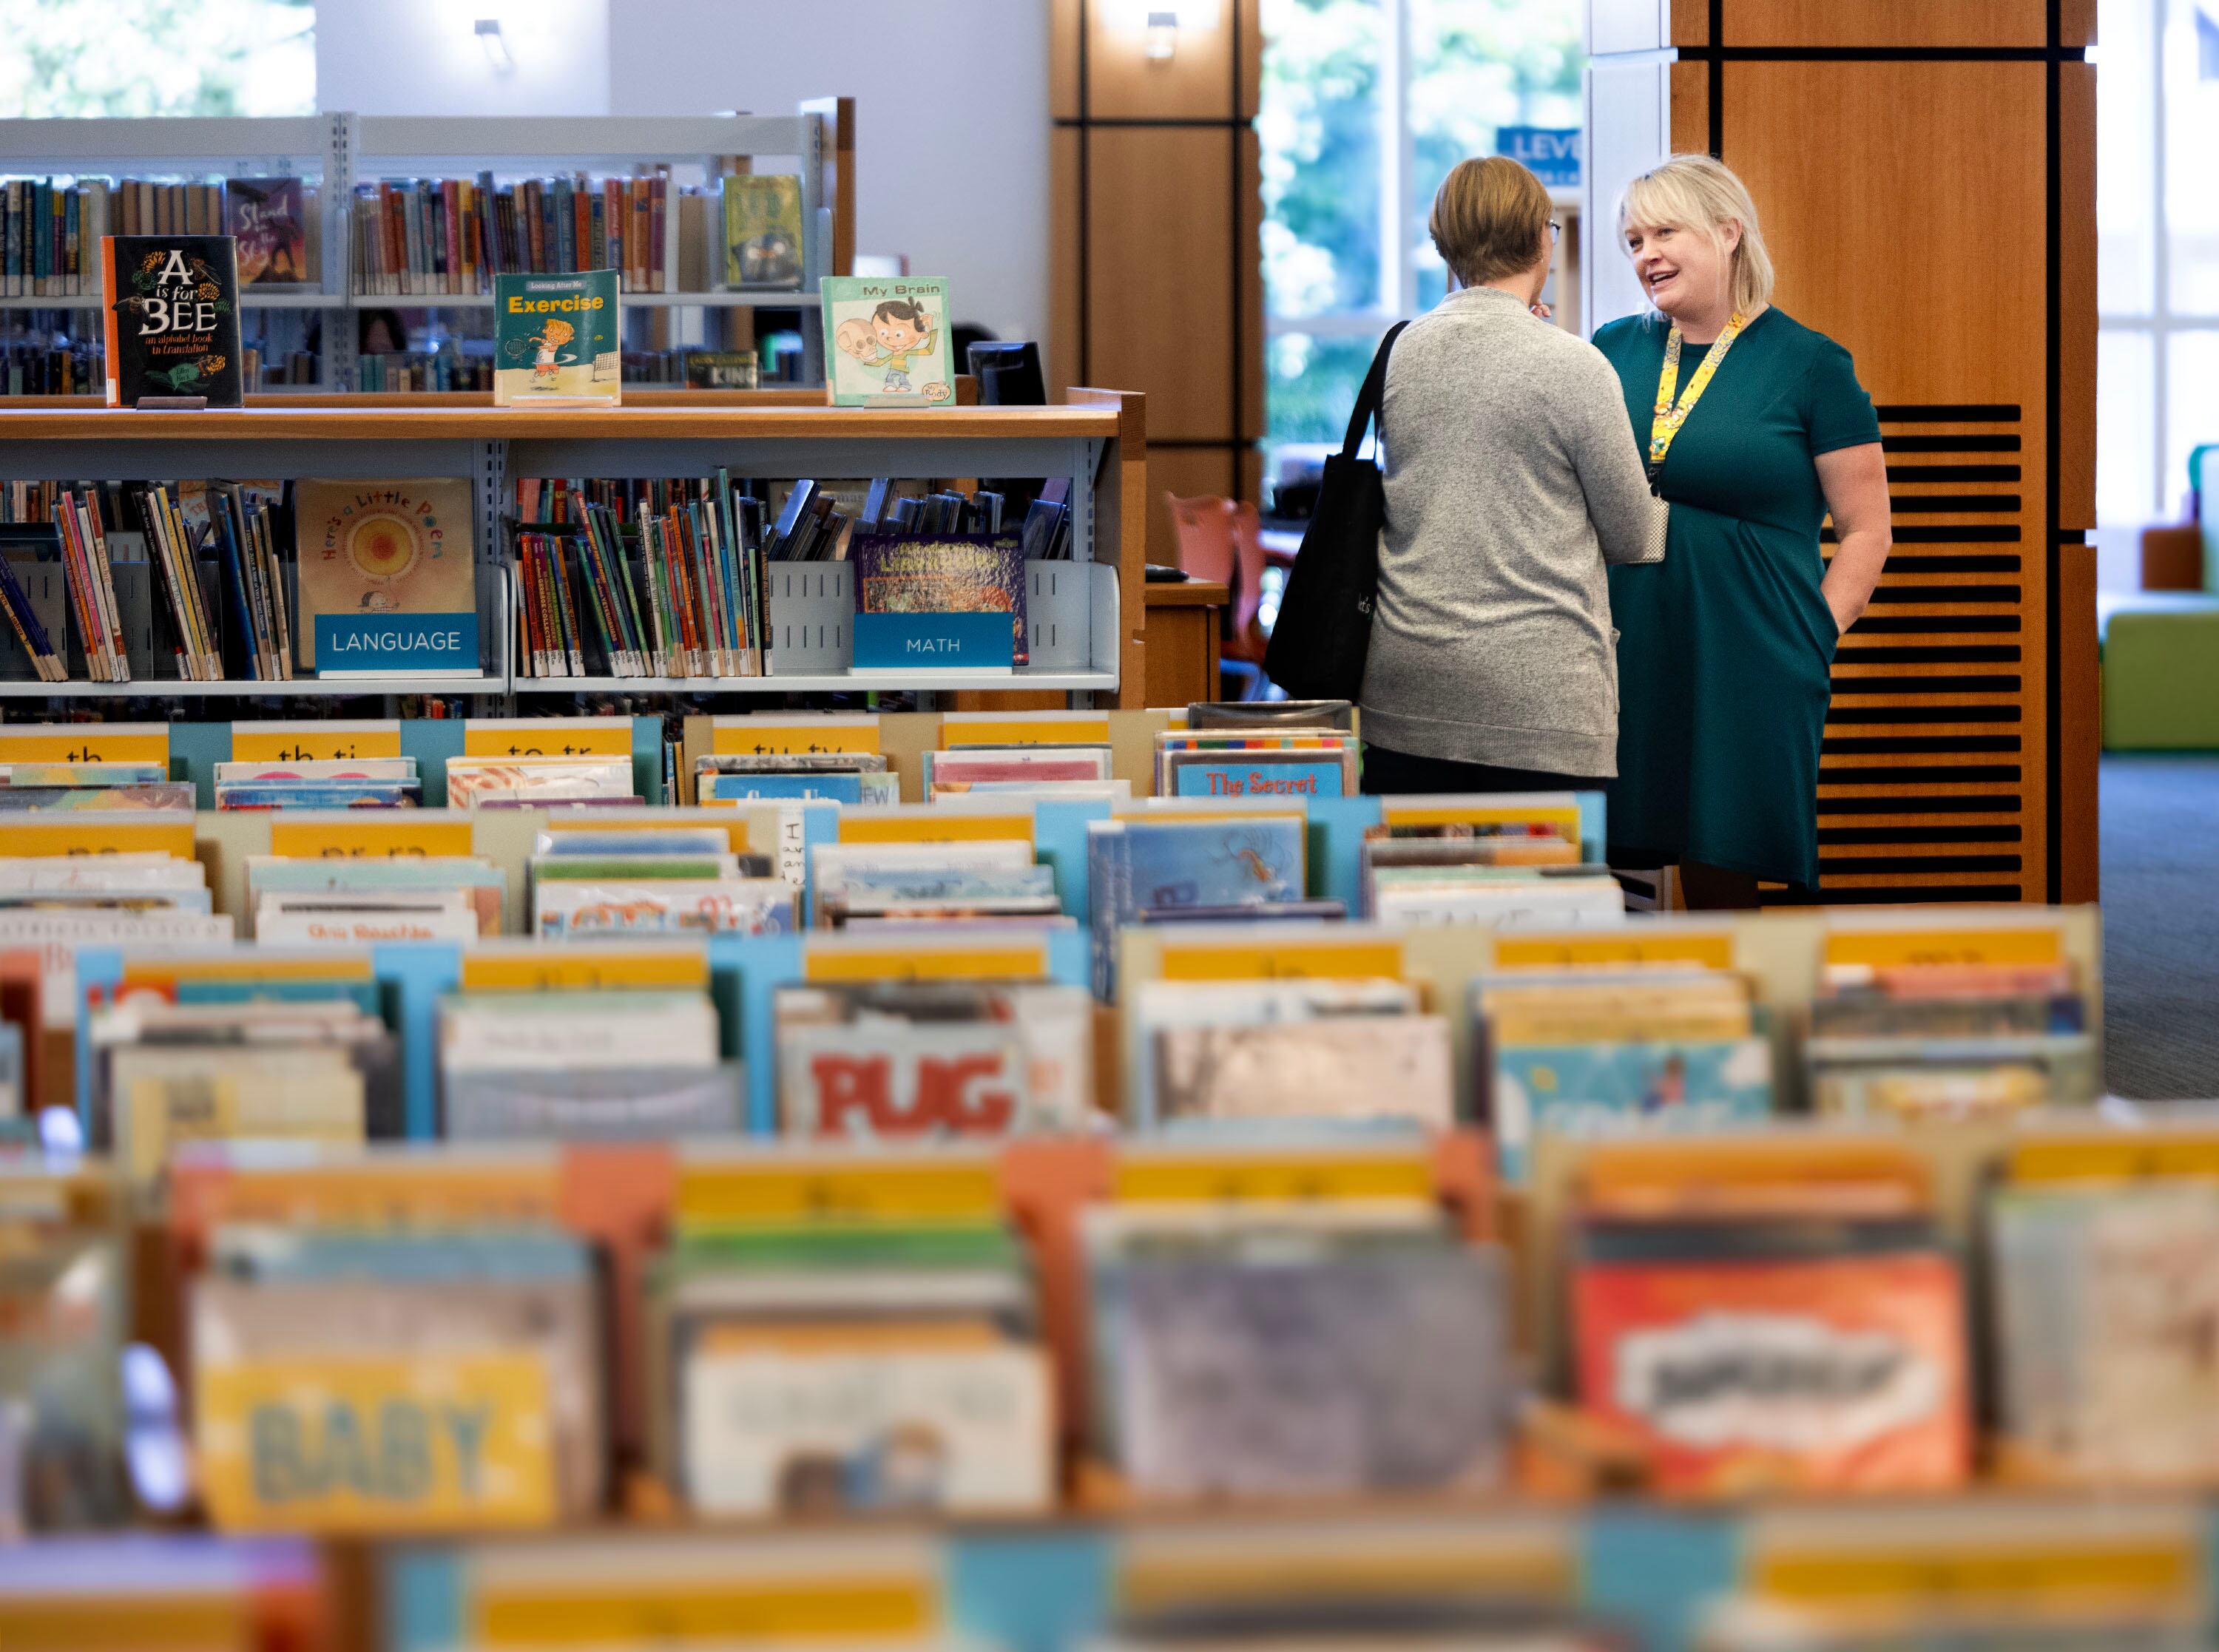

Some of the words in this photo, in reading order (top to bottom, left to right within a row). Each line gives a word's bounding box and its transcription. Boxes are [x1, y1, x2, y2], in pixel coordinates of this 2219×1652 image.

[158, 250, 194, 285] A
[156, 285, 169, 297] is
[172, 285, 198, 302] for
[863, 286, 888, 297] My
[895, 284, 940, 295] Brain
[508, 294, 604, 314] Exercise
[138, 297, 218, 335] BEE
[152, 345, 162, 355] in
[163, 344, 209, 354] translation
[158, 335, 190, 345] alphabet
[192, 334, 213, 344] book
[321, 515, 342, 561] Here's
[343, 505, 354, 516] a
[355, 490, 411, 509] Little
[169, 574, 178, 586] CAT
[87, 588, 95, 609] World
[538, 578, 547, 607] GARBAGE
[599, 598, 618, 641] VETERINARIANS
[333, 632, 462, 651] LANGUAGE
[906, 638, 960, 652] MATH
[1206, 773, 1243, 795] The
[1249, 771, 1317, 794] Secret
[811, 1054, 1016, 1136] PUG
[250, 1400, 494, 1503] BABY
